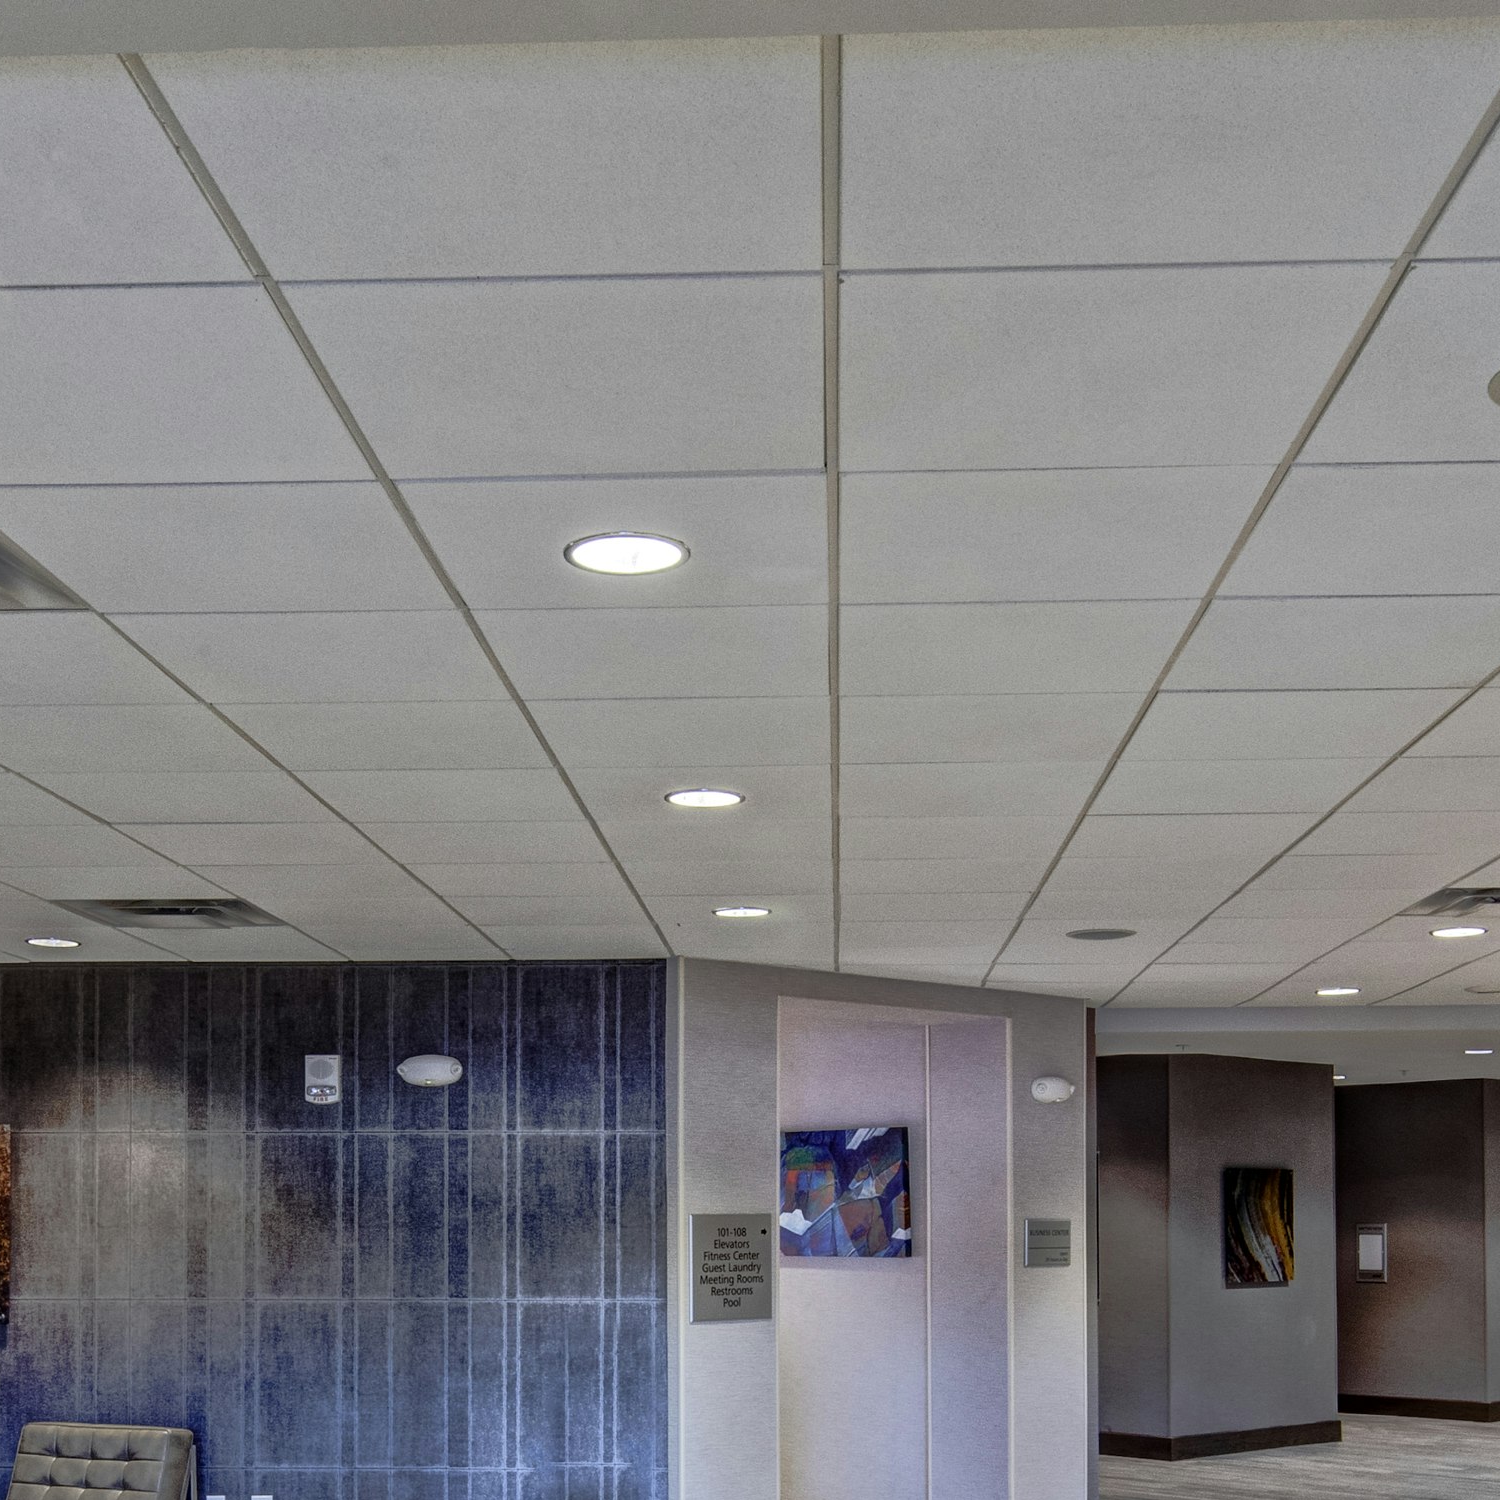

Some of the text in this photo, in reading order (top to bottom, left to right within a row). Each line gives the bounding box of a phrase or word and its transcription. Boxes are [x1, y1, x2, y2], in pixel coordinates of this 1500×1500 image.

[717, 1227, 747, 1237] 101-108
[713, 1239, 750, 1249] Elevators
[703, 1250, 760, 1261] Fitness Center
[702, 1262, 762, 1274] Guest Laundry
[699, 1274, 764, 1286] Meeting Rooms
[710, 1286, 753, 1296] Restrooms
[723, 1297, 741, 1308] Pool
